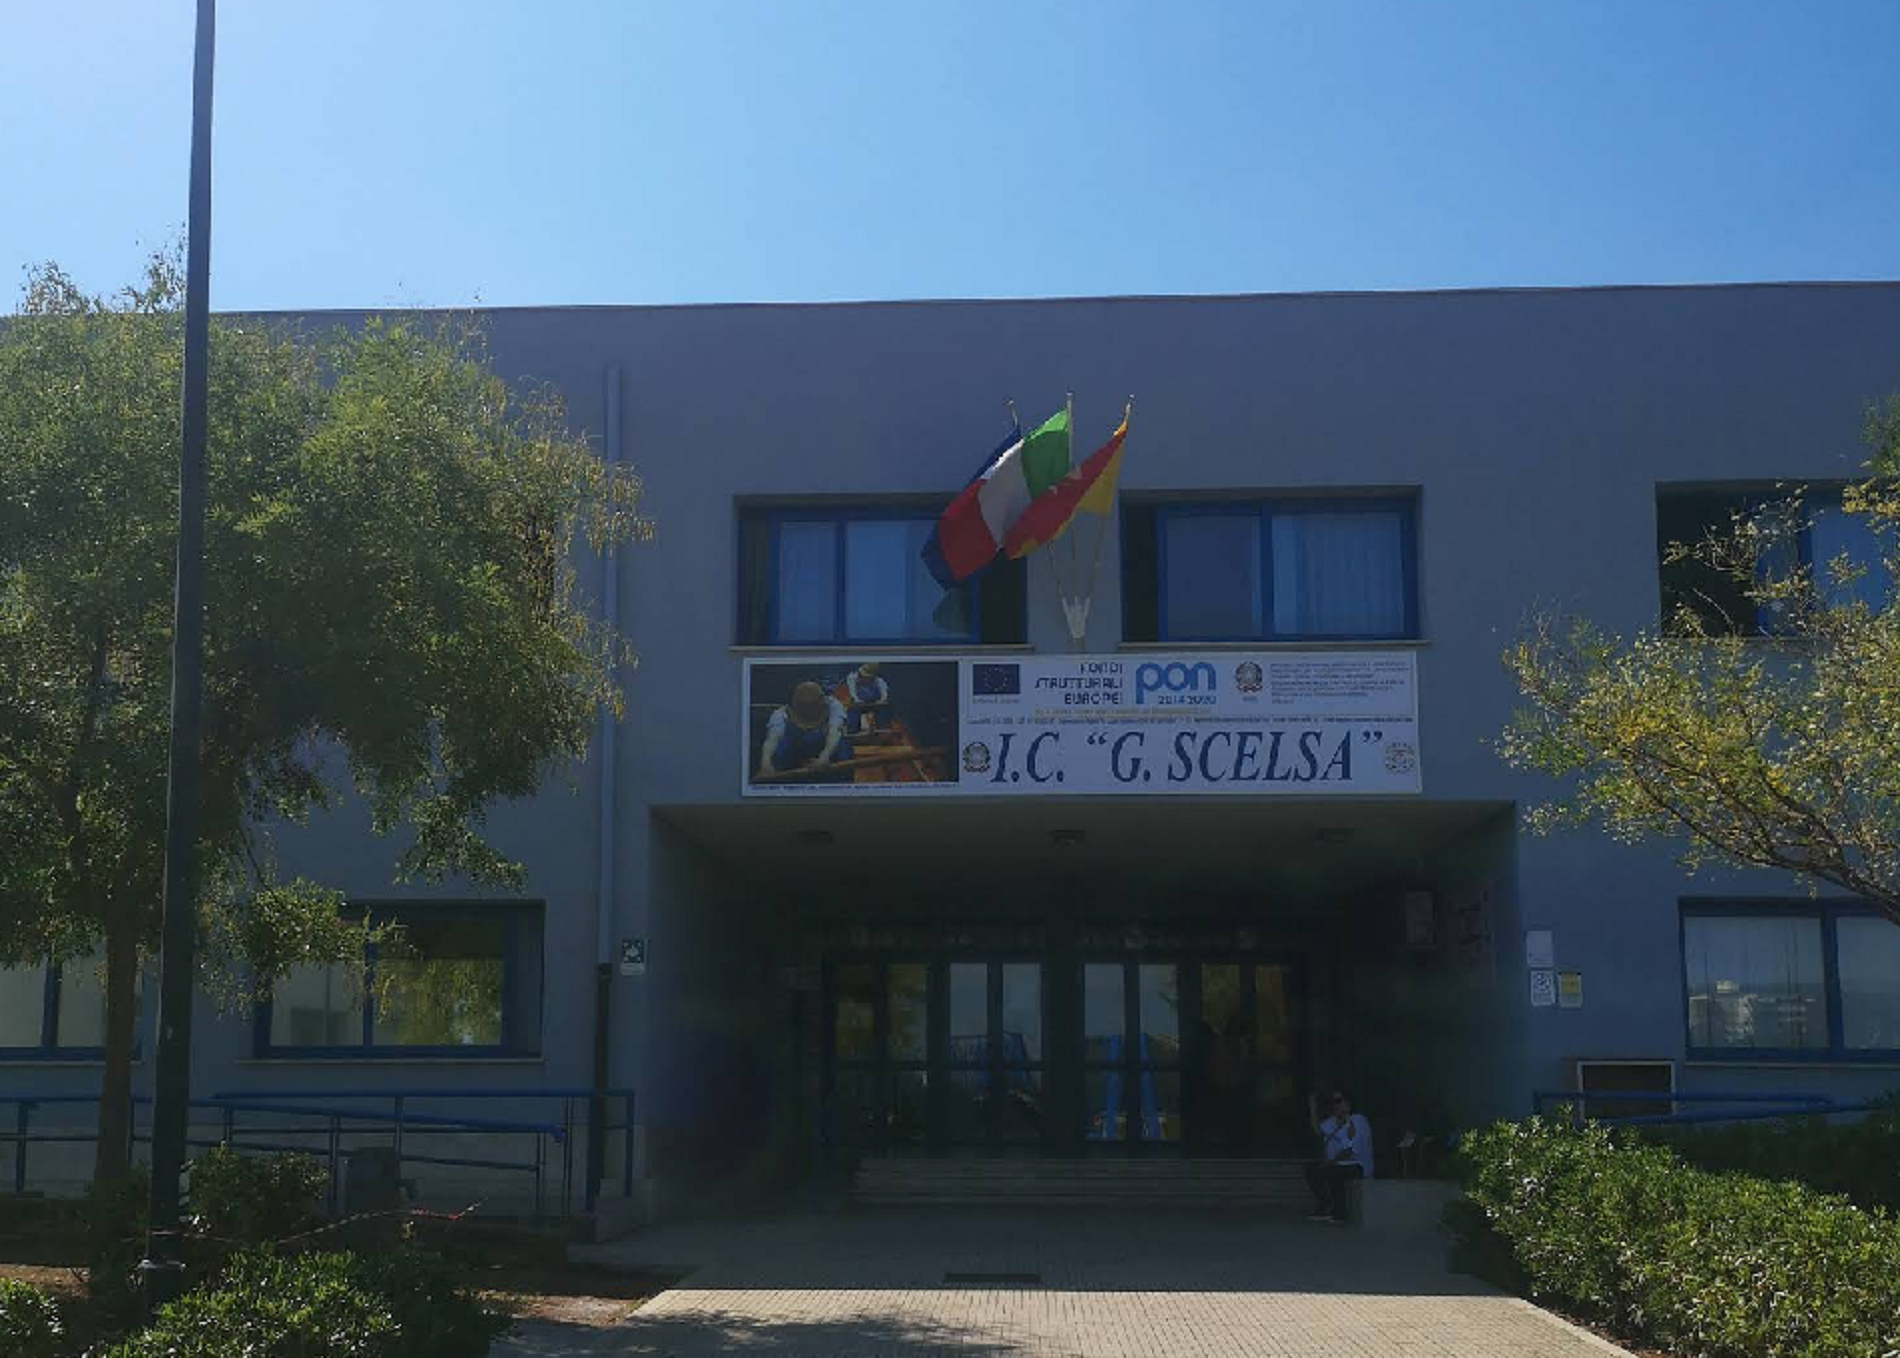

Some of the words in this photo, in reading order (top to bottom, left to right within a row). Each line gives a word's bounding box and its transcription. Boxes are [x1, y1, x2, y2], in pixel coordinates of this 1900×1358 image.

[1081, 661, 1122, 674] FONDI
[1035, 677, 1122, 689] STRUTTURALI
[1064, 692, 1122, 705] EUROPEI
[990, 731, 1064, 783] I.C.
